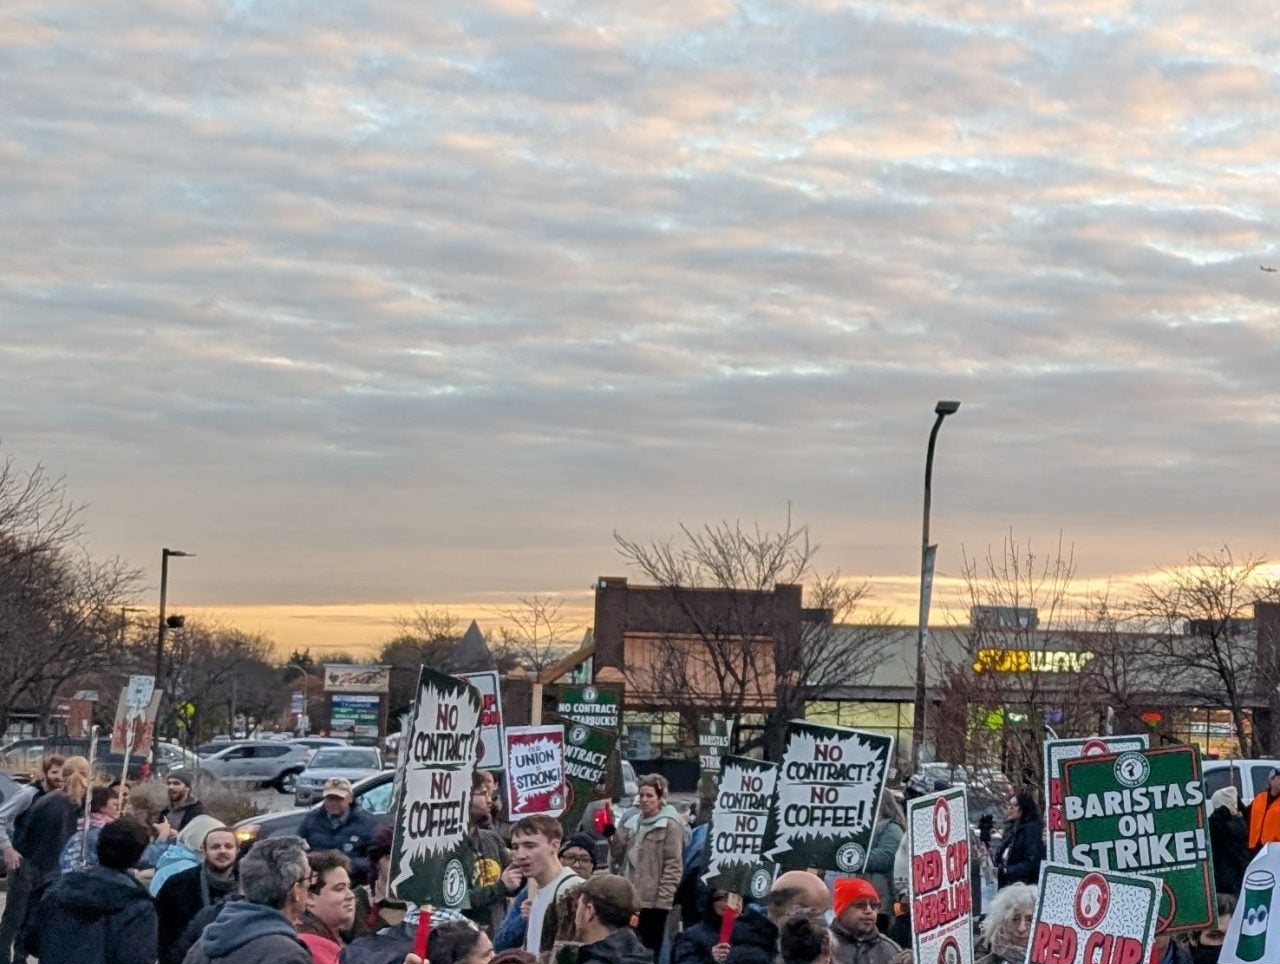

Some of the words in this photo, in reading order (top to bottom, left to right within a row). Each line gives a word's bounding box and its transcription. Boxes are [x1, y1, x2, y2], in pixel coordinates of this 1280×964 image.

[436, 703, 459, 732] NO
[558, 702, 571, 713] NO
[413, 729, 475, 763] CONTRACT?
[564, 744, 607, 769] NTRACT,
[814, 744, 843, 761] NO
[515, 750, 555, 768] UNION
[516, 767, 561, 789] STRONG!
[786, 761, 875, 781] CONTRACT?
[430, 771, 452, 800] NO
[741, 776, 763, 792] NO
[810, 787, 839, 804] NO
[719, 792, 773, 811] CONTRAC
[1064, 780, 1204, 821] BARISTAS
[408, 791, 467, 841] COFFEE!
[735, 816, 758, 832] NO
[784, 800, 866, 828] COFFEE!
[1118, 812, 1156, 838] ON
[715, 832, 762, 854] COFFE
[1071, 828, 1208, 871] STRIKE!
[911, 849, 943, 896] RED
[945, 839, 969, 884] CUP
